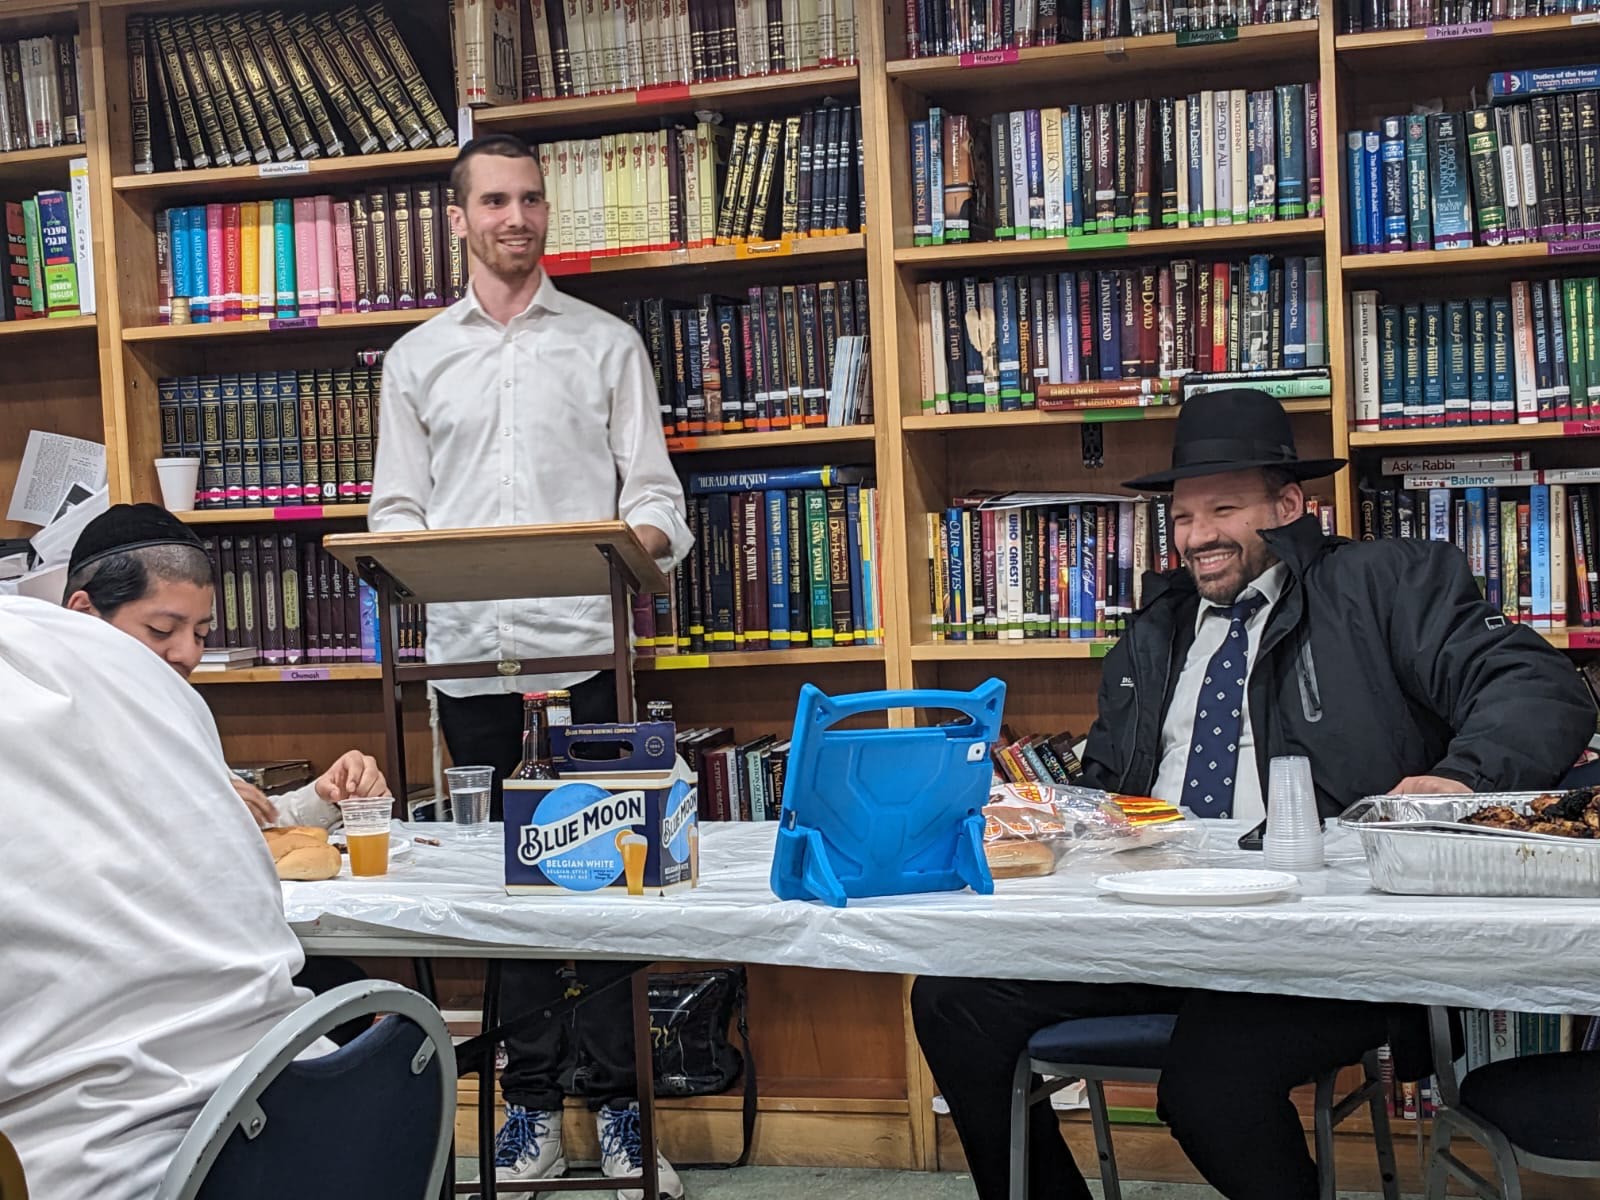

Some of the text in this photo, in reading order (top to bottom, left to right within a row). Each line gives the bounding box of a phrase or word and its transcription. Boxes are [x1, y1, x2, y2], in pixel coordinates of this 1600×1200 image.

[1436, 26, 1482, 36] Pirkei Avos
[976, 54, 1003, 62] History
[1533, 73, 1555, 81] Duties
[1556, 71, 1564, 79] of
[1577, 69, 1598, 77] Heart
[1083, 114, 1091, 129] The
[1310, 108, 1318, 126] Vilna
[1101, 111, 1109, 168] Reb Yaakov
[1191, 106, 1200, 169] Rav Dessler
[1047, 151, 1060, 183] BOSS
[1218, 152, 1228, 168] ALL
[1447, 147, 1457, 188] ORCHOS
[915, 167, 925, 178] IN
[916, 180, 925, 196] HIS
[916, 198, 926, 225] SOUL
[1412, 211, 1420, 221] The
[175, 237, 183, 275] MIDRASH
[193, 235, 203, 273] MIDRASH
[211, 236, 219, 274] MIDRASH
[227, 234, 235, 272] MIDRASH
[277, 230, 286, 267] MIDRASH
[1176, 280, 1187, 290] A
[1019, 288, 1028, 315] Making
[1101, 279, 1112, 341] LIVING LEGEND
[1142, 291, 1155, 329] DOVID
[1177, 325, 1185, 334] in
[1361, 302, 1369, 336] GROWTH
[1384, 318, 1394, 339] Strive
[1408, 316, 1417, 336] Strive
[1428, 315, 1438, 335] Strive
[1453, 312, 1463, 333] Strive
[1474, 311, 1484, 331] Strive
[1495, 310, 1505, 332] Strive
[949, 319, 961, 360] of Truth
[1002, 332, 1010, 344] The
[1384, 339, 1395, 349] for
[1407, 337, 1417, 347] for
[1427, 336, 1438, 346] for
[1451, 333, 1463, 343] for
[1473, 331, 1484, 342] for
[1495, 332, 1506, 342] for
[674, 318, 685, 383] Darash Moshe
[743, 315, 754, 380] Darash Moshe
[1020, 321, 1029, 374] Difference
[1361, 338, 1370, 366] through
[1392, 460, 1455, 472] Ask Rabbi
[698, 474, 728, 488] HERALD
[729, 474, 738, 485] OF
[1412, 475, 1495, 487] Life Balance
[1009, 514, 1018, 540] WHO
[1156, 503, 1167, 556] FRONT ROW
[743, 502, 758, 581] TRIUMPH OF SURVIVAL
[1537, 523, 1546, 557] SHOLOM
[949, 520, 962, 591] OUR LIVES
[1083, 557, 1093, 569] the
[291, 669, 320, 679] Chumash
[753, 755, 764, 813] BASTION OF FAITH
[772, 762, 784, 798] Wisdom
[520, 796, 642, 861] BLUE MOON
[663, 791, 697, 846] BLUE MOON
[546, 859, 615, 868] BELGIAN WHITE
